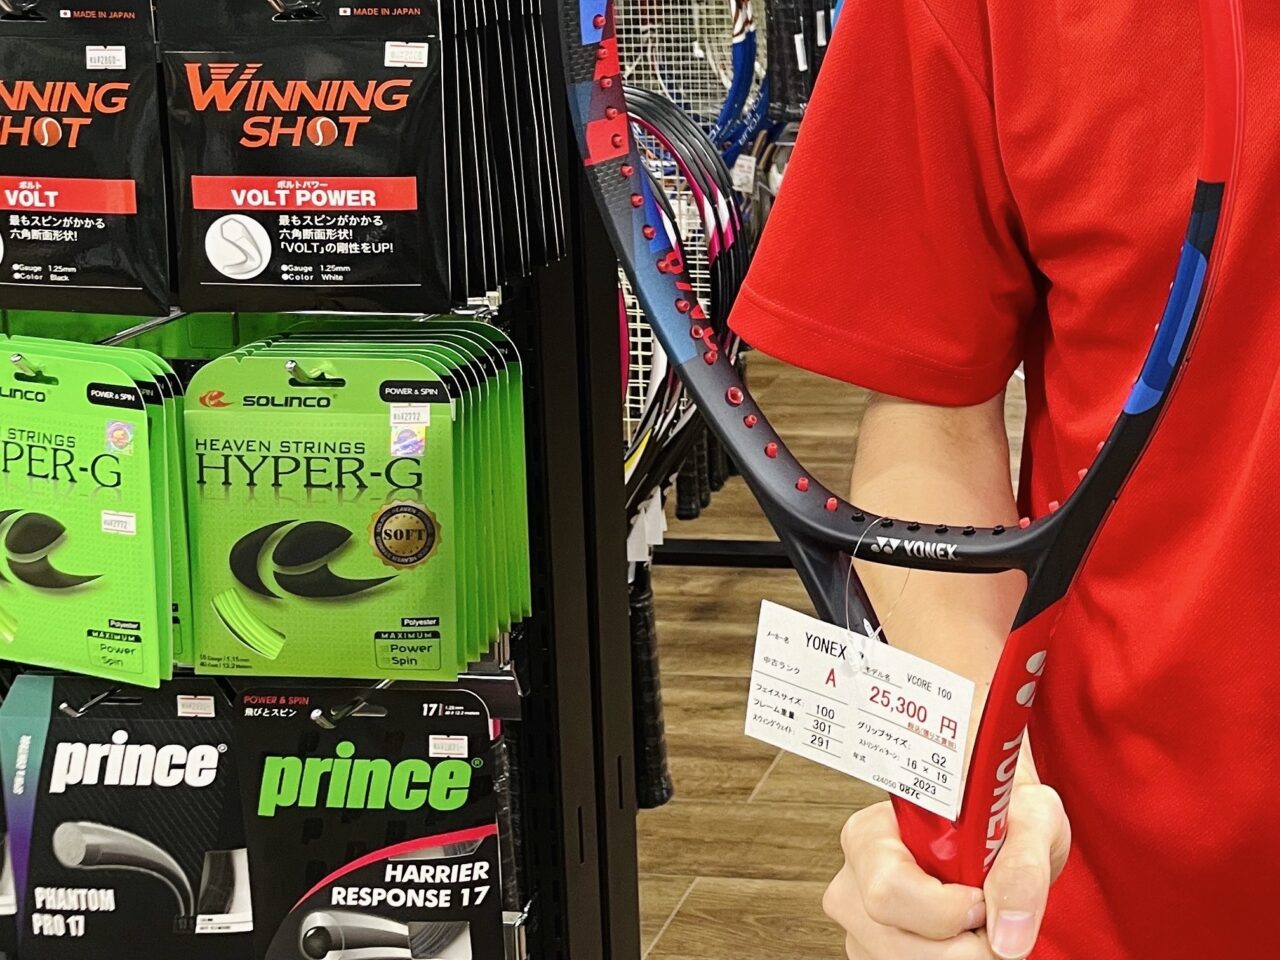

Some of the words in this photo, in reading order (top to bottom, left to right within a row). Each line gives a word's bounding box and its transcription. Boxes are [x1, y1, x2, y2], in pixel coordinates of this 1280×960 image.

[73, 10, 97, 18] MADE
[99, 10, 107, 18] IN
[109, 10, 136, 19] JAPAN
[353, 7, 380, 16] MADE
[382, 7, 390, 16] IN
[392, 7, 421, 16] JAPAN
[183, 62, 412, 112] WINNING
[239, 116, 371, 148] SHOT
[19, 181, 42, 190] ボルト
[277, 180, 328, 189] ボルトパワー
[4, 189, 59, 208] VOLT
[231, 189, 290, 207] VOLT
[295, 189, 377, 207] POWER
[9, 214, 106, 229] 最もスピンがかかる
[279, 214, 384, 227] 最もスピンがかかる
[90, 389, 114, 400] POWER
[120, 392, 136, 402] SPIN
[385, 387, 412, 395] POWER
[420, 387, 438, 395] SPIN
[242, 395, 331, 409] SOLINCO
[8, 428, 76, 448] STRINGS
[196, 438, 271, 452] HEAVEN
[280, 441, 366, 455] STRINGS
[196, 452, 423, 489] HYPER-G
[383, 529, 426, 541] SOFT
[903, 539, 958, 560] YONEX
[404, 618, 437, 627] Polyester
[91, 630, 136, 642] MAXIMUM
[100, 643, 136, 655] Power
[390, 644, 433, 653] Power
[805, 631, 847, 661] YONEX
[391, 656, 418, 667] Spin
[763, 656, 801, 675] 中古ランク
[825, 667, 836, 688] A
[907, 673, 933, 693] VCORE
[937, 686, 952, 701] 100
[243, 695, 279, 705] POWER
[288, 696, 310, 705] SPIN
[244, 707, 298, 718] 飛びとスピン
[422, 702, 437, 717] 17
[815, 704, 835, 720] 100
[869, 685, 928, 724] 25,300
[940, 715, 958, 739] 円
[812, 719, 832, 735] 301
[810, 734, 830, 750] 291
[49, 730, 220, 794] prince
[931, 752, 947, 768] G2
[906, 757, 917, 770] 16
[937, 771, 948, 784] 19
[257, 741, 472, 817] prince
[913, 776, 937, 795] 2023
[899, 782, 921, 800] 087c
[384, 861, 490, 884] HARRIER
[33, 886, 115, 912] PHANTOM
[331, 886, 451, 908] RESPONSE
[458, 885, 490, 907] 17
[32, 913, 67, 936] PRO
[67, 914, 86, 937] 17
